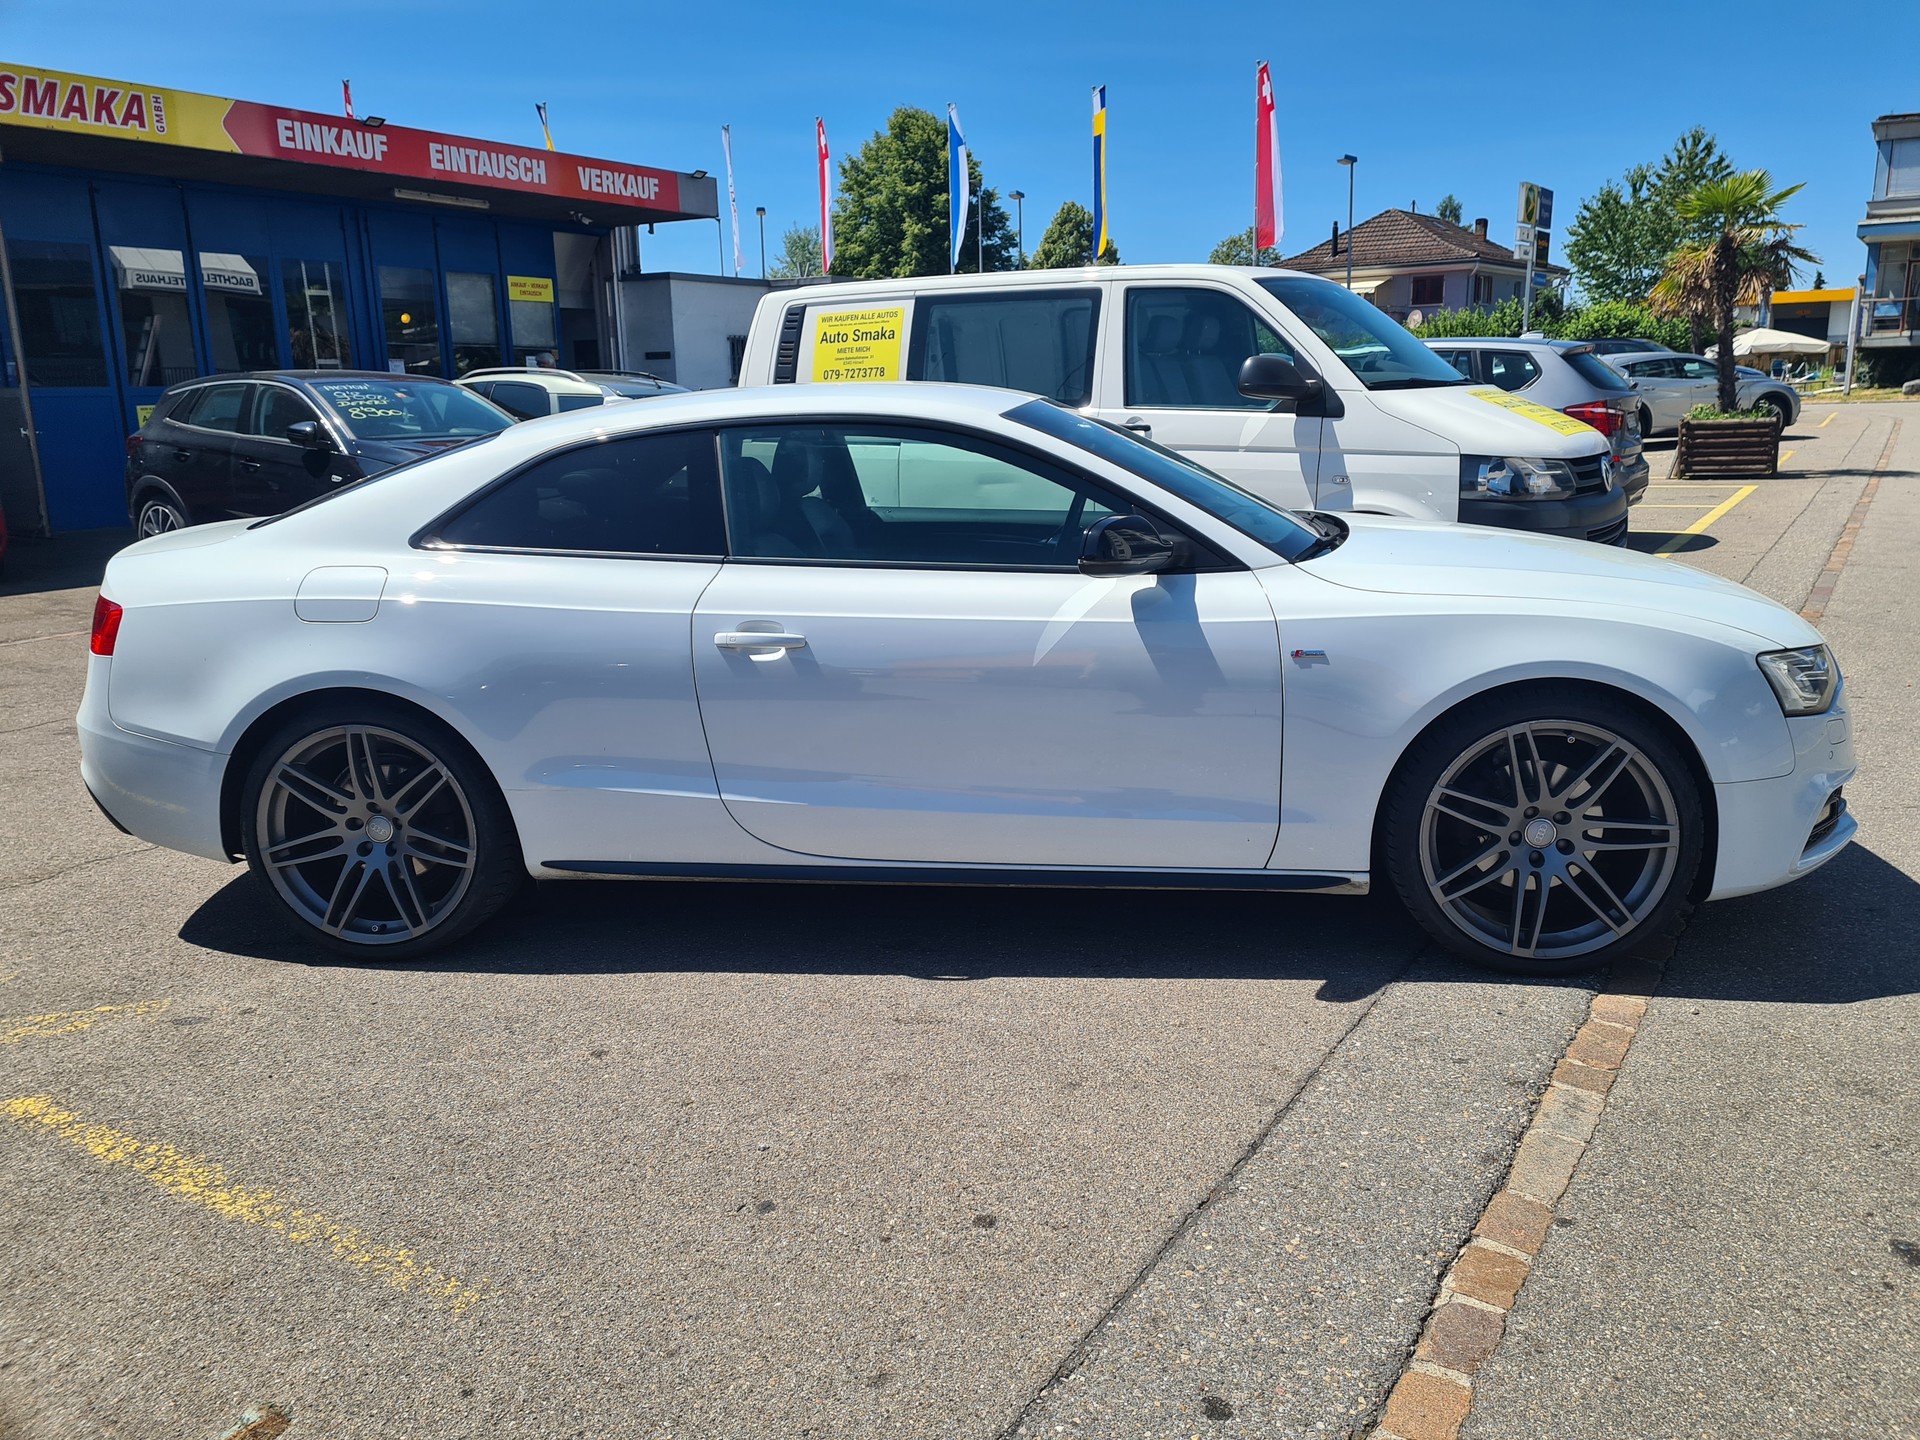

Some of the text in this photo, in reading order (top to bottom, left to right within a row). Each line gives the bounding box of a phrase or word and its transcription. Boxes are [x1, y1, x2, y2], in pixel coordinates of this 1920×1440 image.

[0, 74, 147, 129] SMAKA
[152, 95, 165, 133] GMBH
[277, 118, 659, 200] EINKAUF EINTAUSCH VERKAUF
[834, 314, 859, 323] KAUFEN
[860, 312, 876, 320] ALLE
[876, 311, 898, 319] AUTOS
[819, 326, 895, 345] Auto Smaka
[823, 366, 885, 380] 079-7273778
